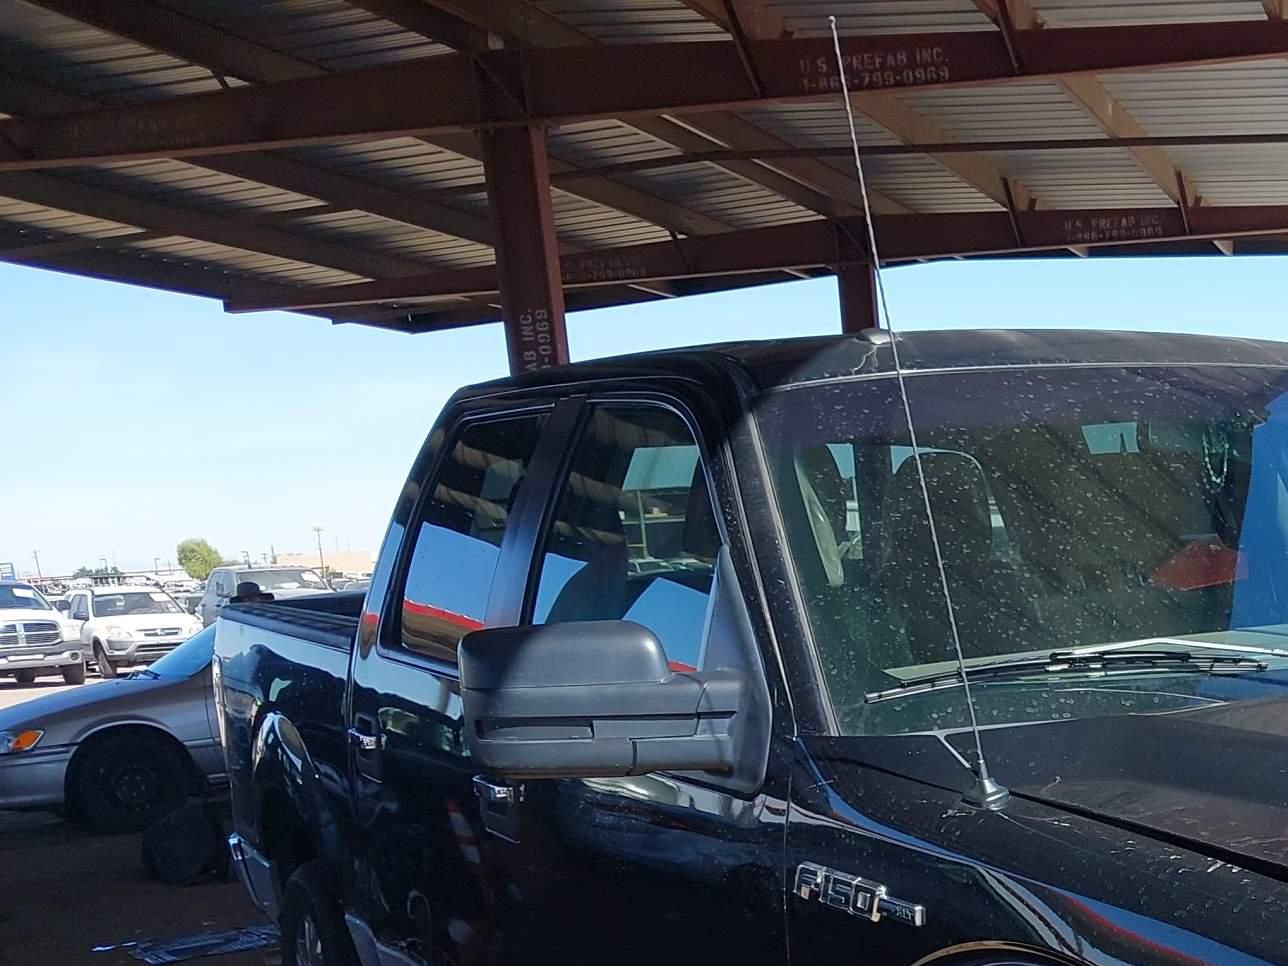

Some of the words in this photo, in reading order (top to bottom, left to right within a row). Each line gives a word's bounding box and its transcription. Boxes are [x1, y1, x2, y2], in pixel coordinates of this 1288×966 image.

[842, 50, 907, 71] PREFAB
[915, 47, 949, 64] INC.
[520, 308, 535, 341] INC.
